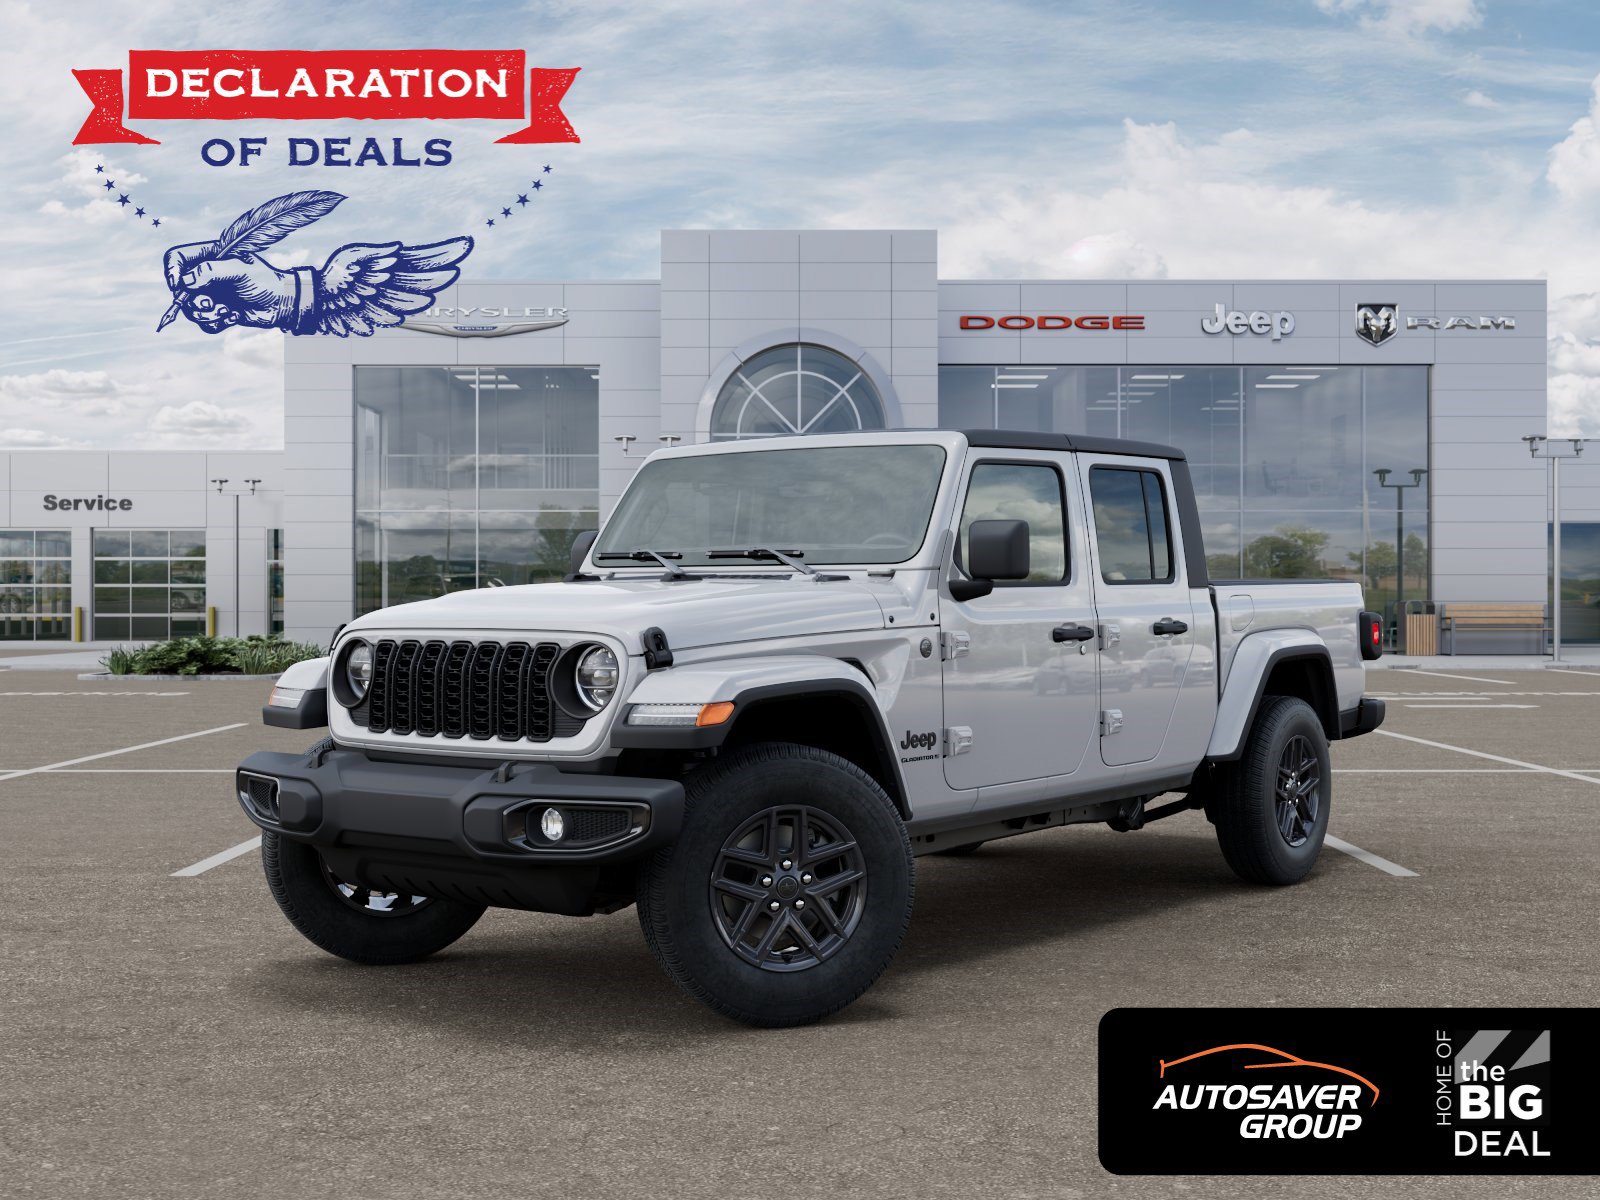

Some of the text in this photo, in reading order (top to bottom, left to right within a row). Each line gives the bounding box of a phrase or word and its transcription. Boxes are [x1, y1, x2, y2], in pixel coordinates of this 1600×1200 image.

[410, 307, 569, 318] RYSLER
[959, 316, 1145, 330] DODGE
[1201, 303, 1295, 341] Jeep
[1406, 317, 1515, 330] RAM
[43, 494, 132, 512] Service
[900, 730, 937, 751] Jeep
